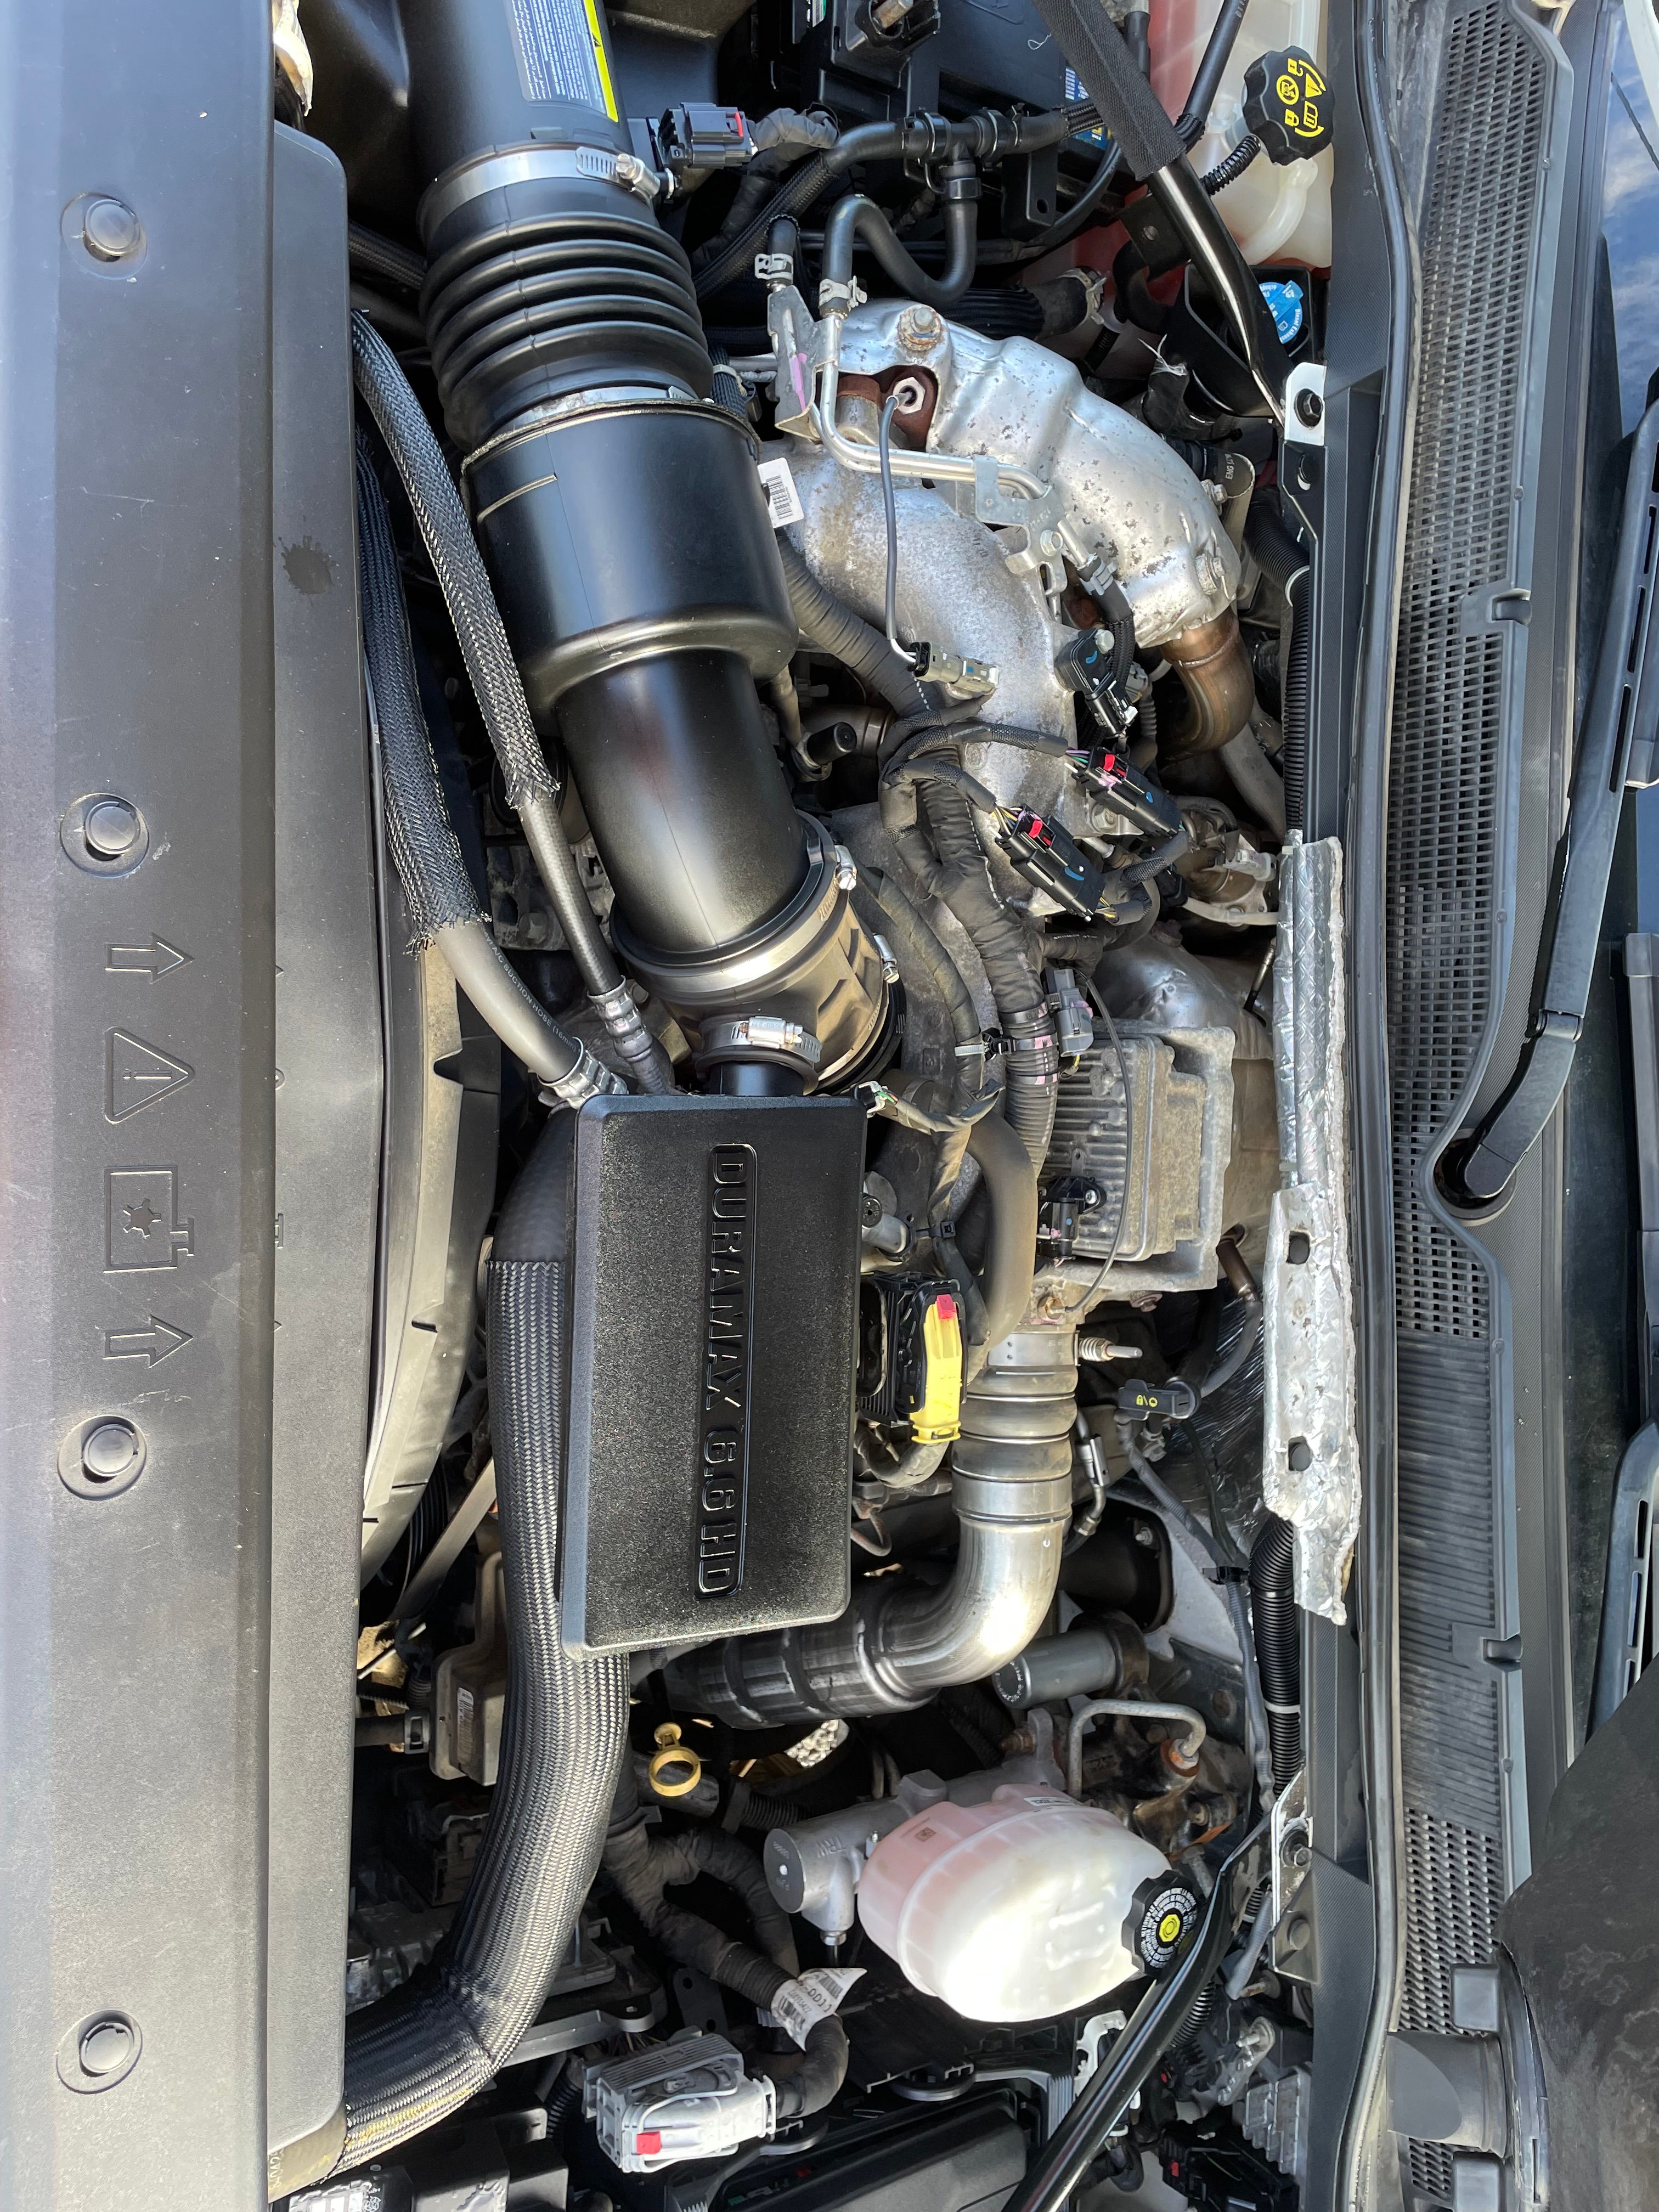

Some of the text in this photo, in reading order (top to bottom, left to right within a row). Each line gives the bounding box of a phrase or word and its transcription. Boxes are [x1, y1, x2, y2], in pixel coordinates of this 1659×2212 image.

[1225, 465, 1234, 479] ENG
[492, 946, 576, 1052] A/C SUCTION HOSE (16mm)
[698, 1153, 747, 1593] DURAMAX 6.6 HD
[816, 1835, 847, 1859] TRW
